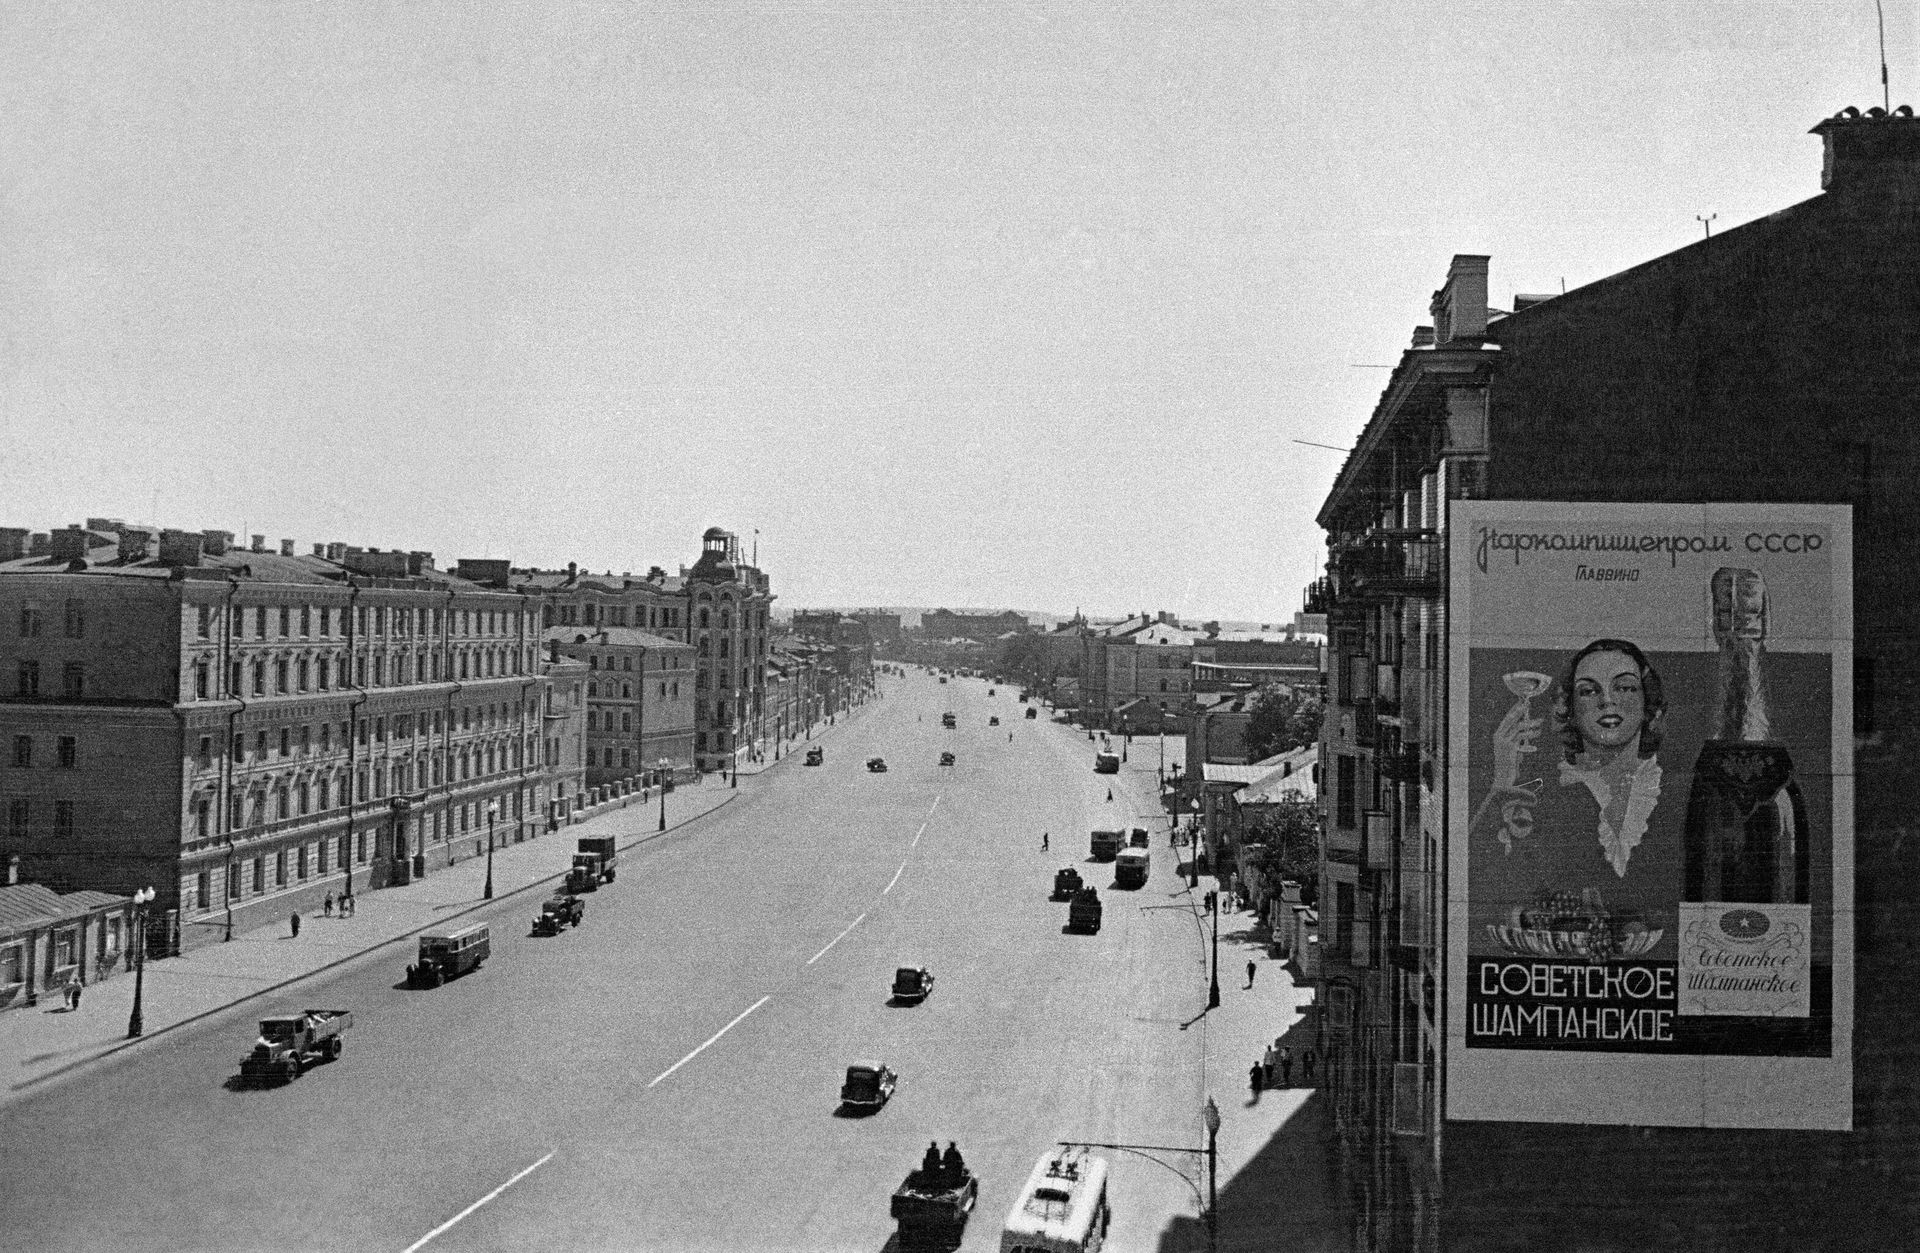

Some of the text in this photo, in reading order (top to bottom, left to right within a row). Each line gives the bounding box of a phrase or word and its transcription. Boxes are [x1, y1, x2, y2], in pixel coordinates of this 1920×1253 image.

[1476, 526, 1823, 574] Наркомпищепром СССР
[1480, 963, 1675, 1000] СОВЕТСКОЕ
[1473, 1003, 1674, 1041] ШАМПАНСКОЕ
